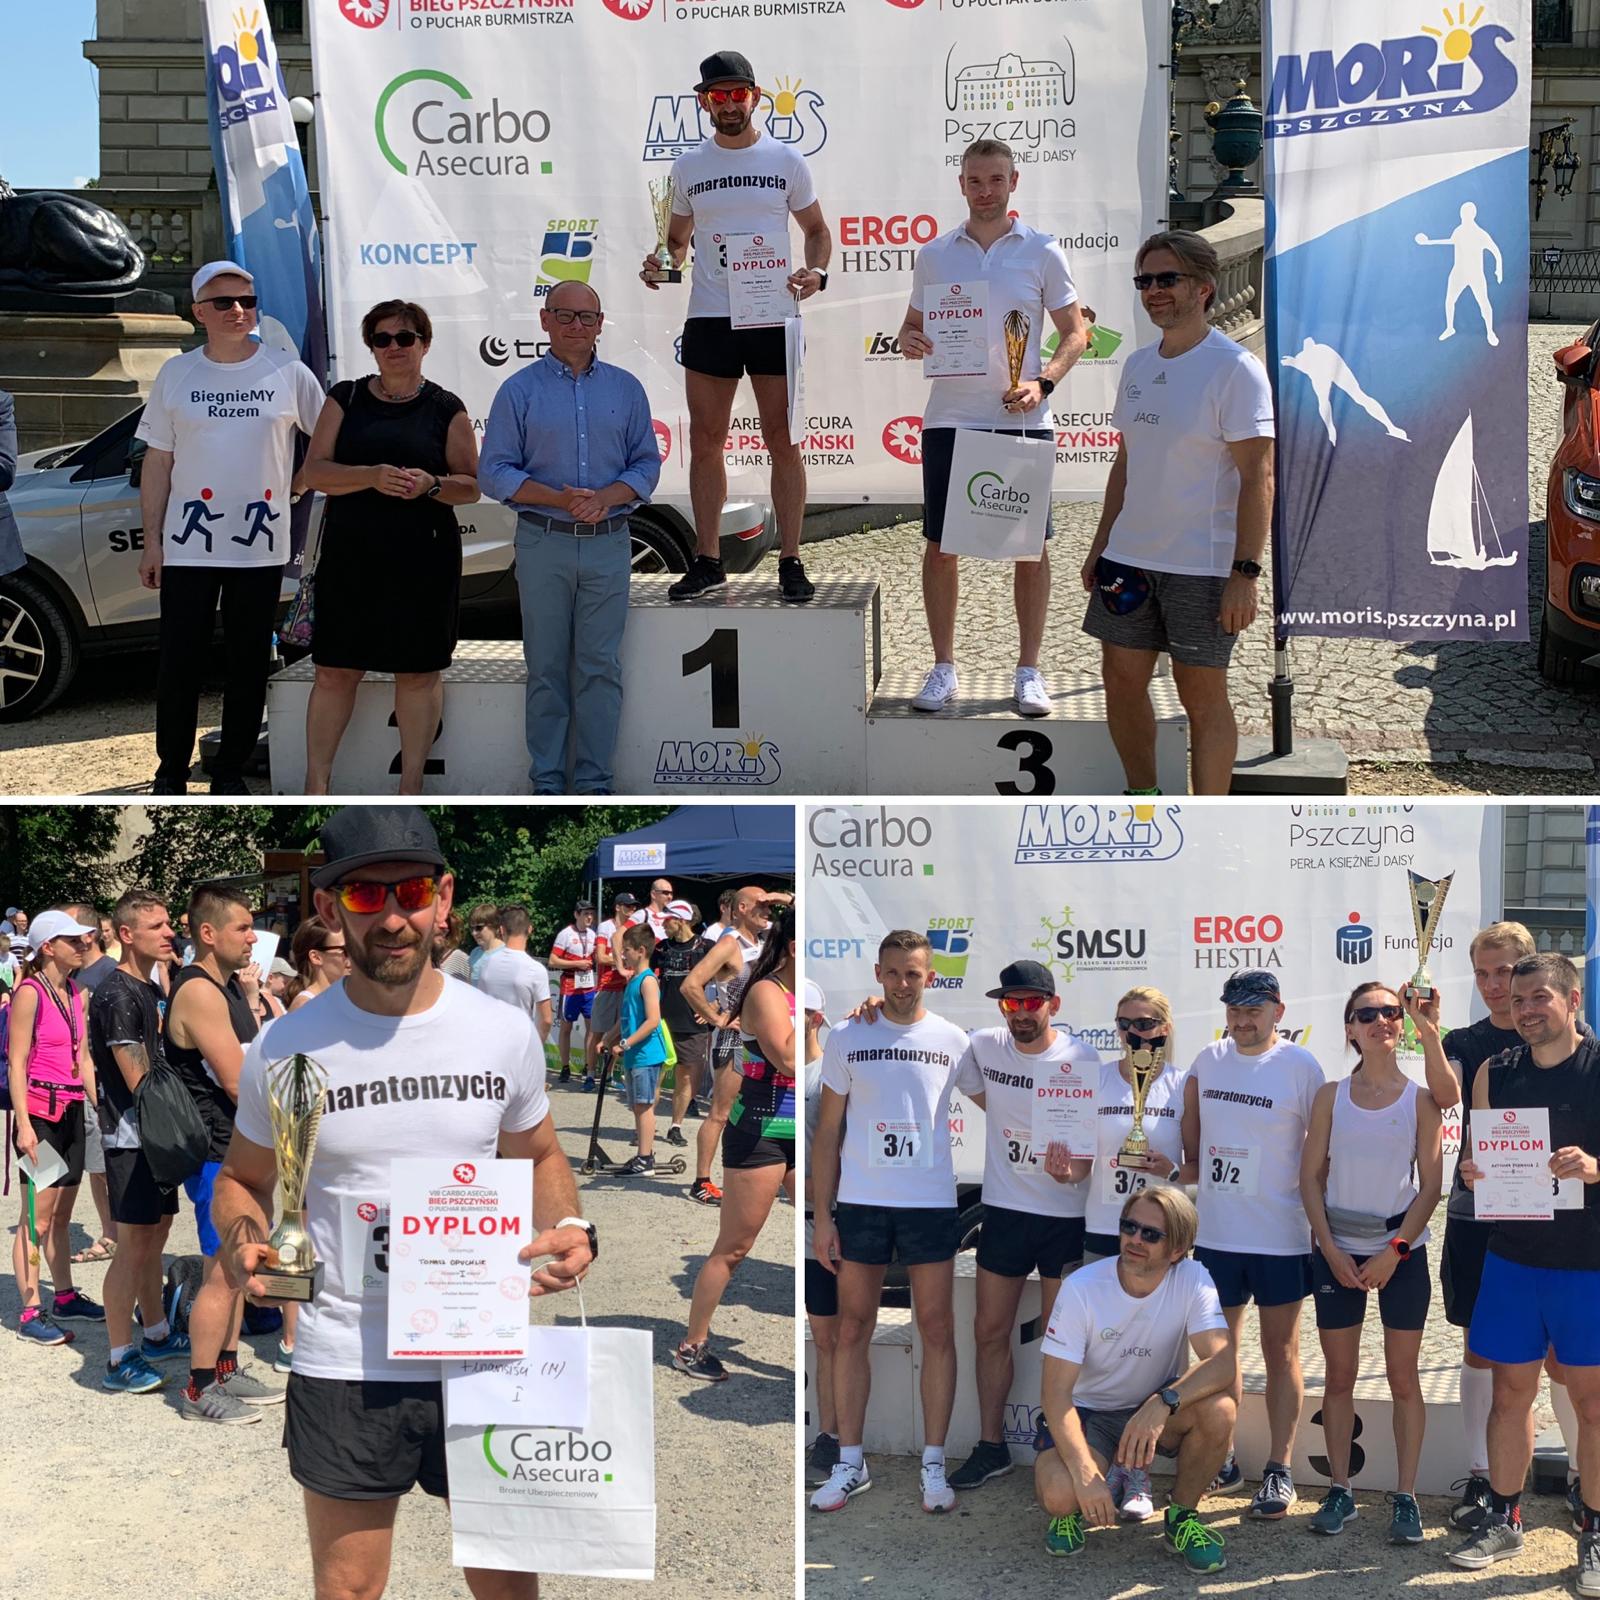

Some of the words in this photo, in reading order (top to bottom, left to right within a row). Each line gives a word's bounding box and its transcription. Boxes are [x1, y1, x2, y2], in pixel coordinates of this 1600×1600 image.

[411, 17, 422, 28] O
[426, 15, 481, 28] PUCHAR
[485, 12, 574, 26] BURMISTRZA
[676, 8, 688, 20] O
[692, 5, 750, 19] PUCHAR
[754, 1, 846, 16] BURMISTRZA
[412, 98, 551, 145] Carbo
[1276, 100, 1474, 134] PSZCZYNA
[945, 118, 1076, 148] Pszczyna
[415, 150, 530, 176] Asecura
[1043, 149, 1077, 162] DAISY
[687, 175, 787, 198] #maratonzycia
[547, 219, 599, 232] SPORT
[840, 215, 938, 246] ERGO
[360, 242, 478, 265] KONCEPT
[841, 249, 915, 273] HESTI
[733, 259, 786, 271] DYPLOM
[929, 308, 983, 320] DYPLOM
[191, 389, 275, 405] BiegnieMY
[208, 404, 259, 418] Razem
[1052, 413, 1114, 427] ASECUR
[729, 417, 761, 430] ARB
[726, 454, 763, 466] CHAR
[1056, 451, 1118, 463] RMISTRZ
[980, 483, 1030, 504] Carbo
[978, 499, 1022, 514] Asecura
[682, 629, 741, 729] 1
[995, 730, 1056, 795] 3
[808, 806, 932, 848] Carbo
[1290, 823, 1414, 853] Pszczyna
[811, 852, 913, 877] Asecura
[1023, 850, 1154, 861] PSZCZYNA
[1290, 857, 1324, 869] PERŁA
[1329, 855, 1380, 869] KSIĘŻNEJ
[1384, 854, 1415, 867] DAISY
[928, 917, 974, 930] SPORT
[1194, 914, 1284, 944] ERGO
[805, 938, 866, 959] CEPT
[1056, 929, 1146, 959] SMSU
[1384, 934, 1453, 952] Funcja
[1194, 947, 1280, 969] HESTIA
[847, 1047, 950, 1067] #maratonzycia
[983, 1065, 1034, 1089] #marato
[322, 1071, 506, 1115] aratonzycia
[1038, 1088, 1093, 1098] DYPLOM
[1203, 1088, 1273, 1109] #maratonzycia
[884, 1134, 913, 1157] 3/1
[1479, 1139, 1544, 1152] DYPLOM
[1212, 1158, 1240, 1185] 3/2
[428, 1197, 447, 1205] BIEG
[403, 1216, 520, 1236] DYPLOM
[1120, 1346, 1152, 1358] JACEK
[510, 1432, 613, 1462] Carbo
[512, 1463, 600, 1483] Asecura
[499, 1486, 526, 1494] Broker
[527, 1488, 599, 1499] Ubezpieczeniowy
